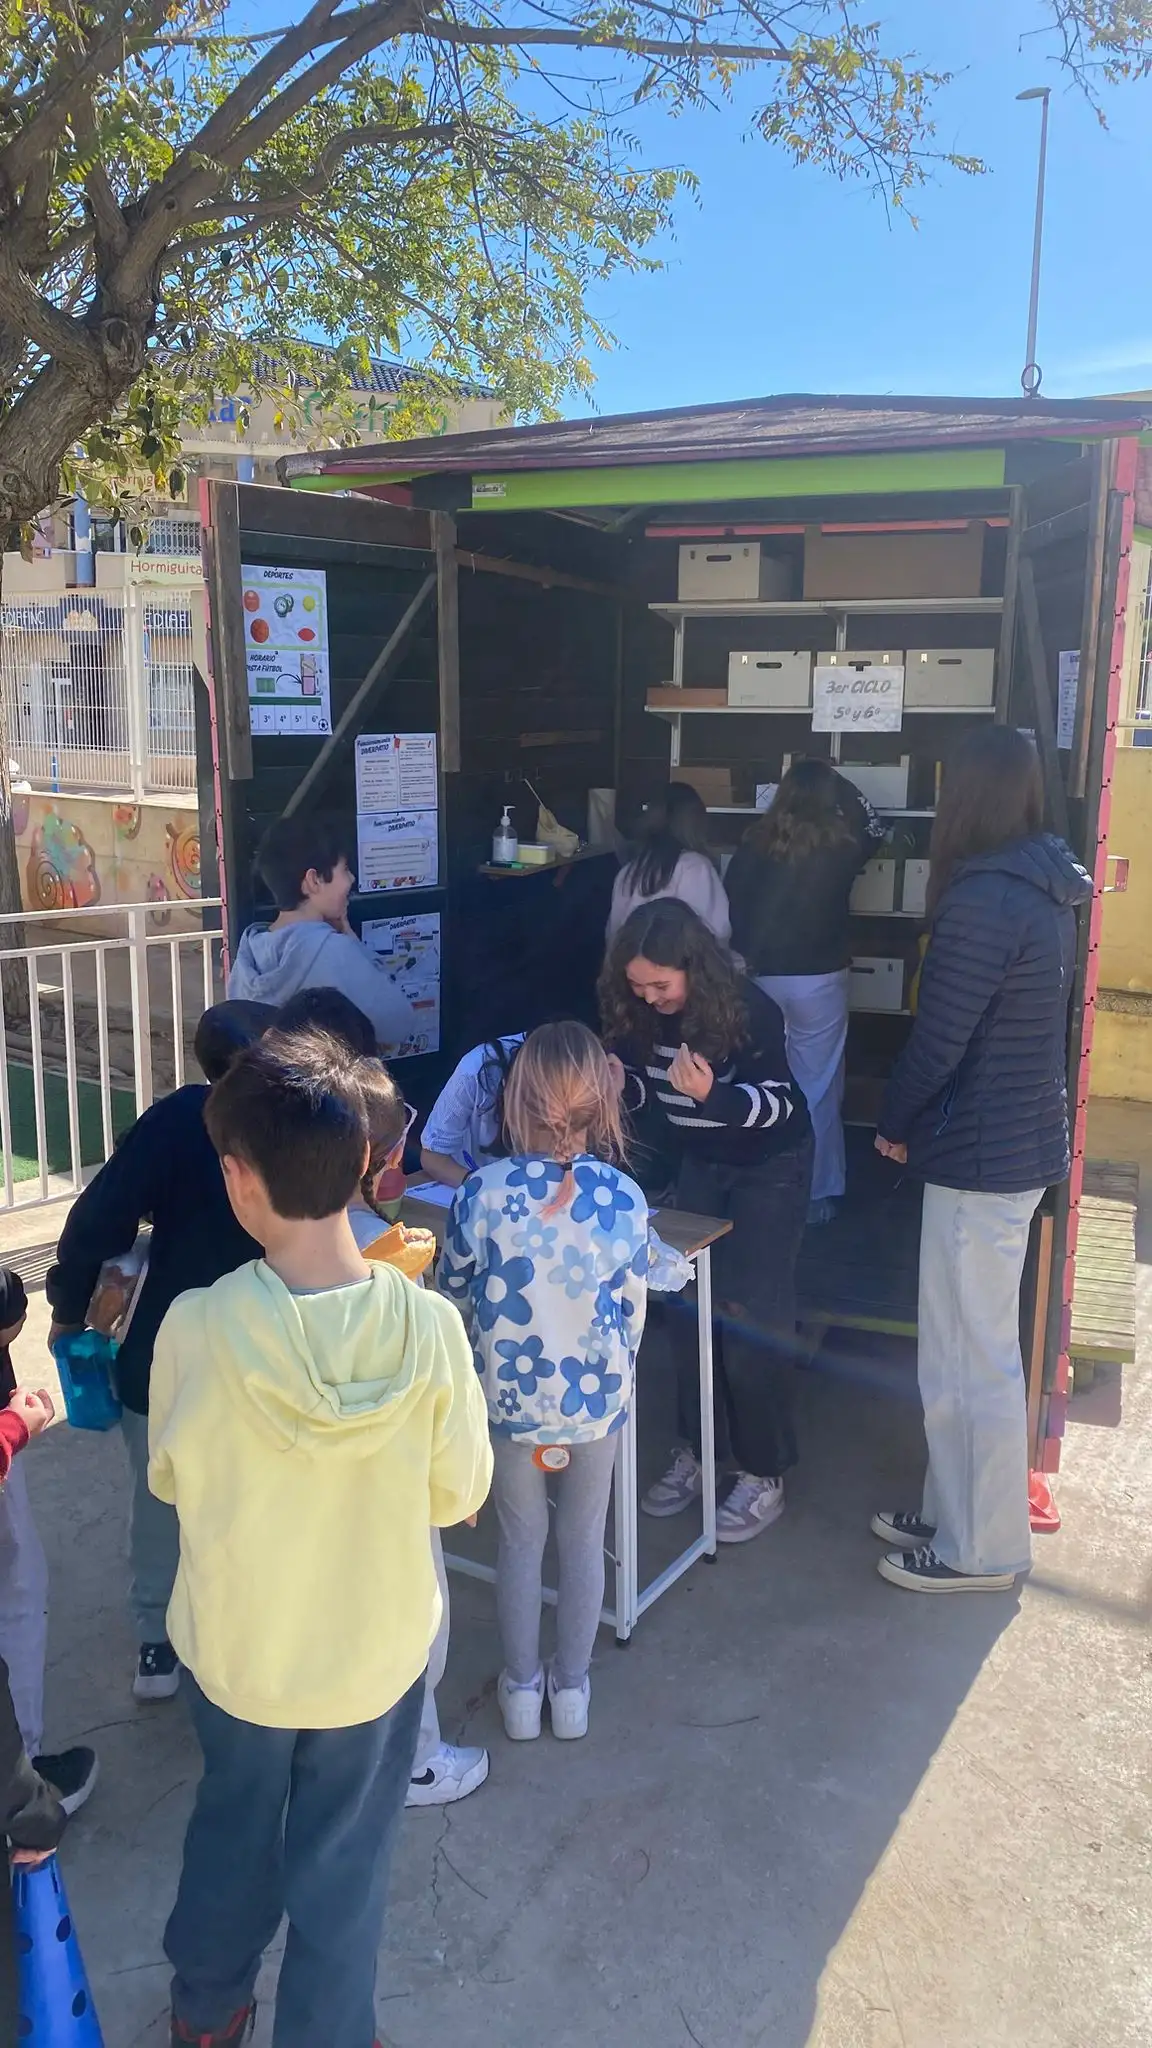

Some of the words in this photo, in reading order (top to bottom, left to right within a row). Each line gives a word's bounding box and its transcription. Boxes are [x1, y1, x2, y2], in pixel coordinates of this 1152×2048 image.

[825, 680, 849, 694] 3er
[850, 679, 892, 694] CICLO
[851, 710, 862, 722] y
